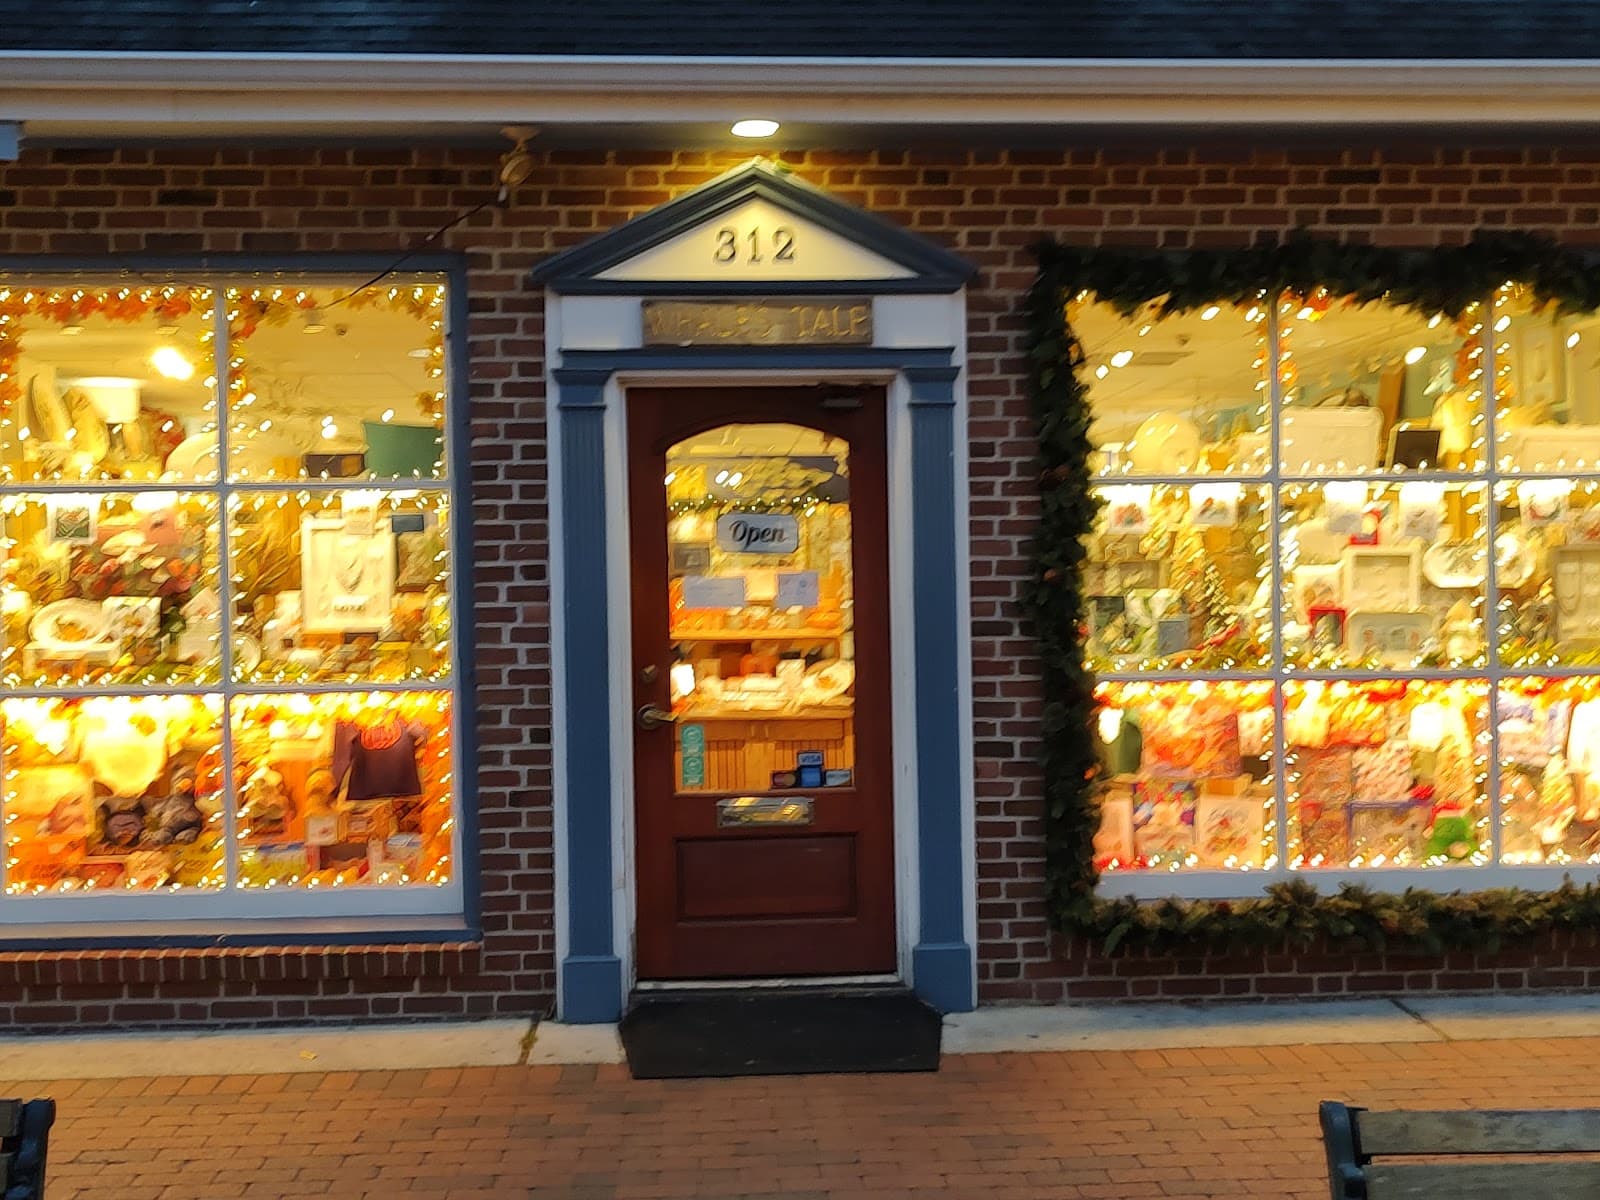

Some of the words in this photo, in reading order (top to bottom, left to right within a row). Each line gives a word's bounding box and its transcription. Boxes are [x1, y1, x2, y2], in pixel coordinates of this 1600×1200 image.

[713, 226, 797, 264] 312
[790, 305, 867, 338] TALE
[729, 520, 789, 550] Open
